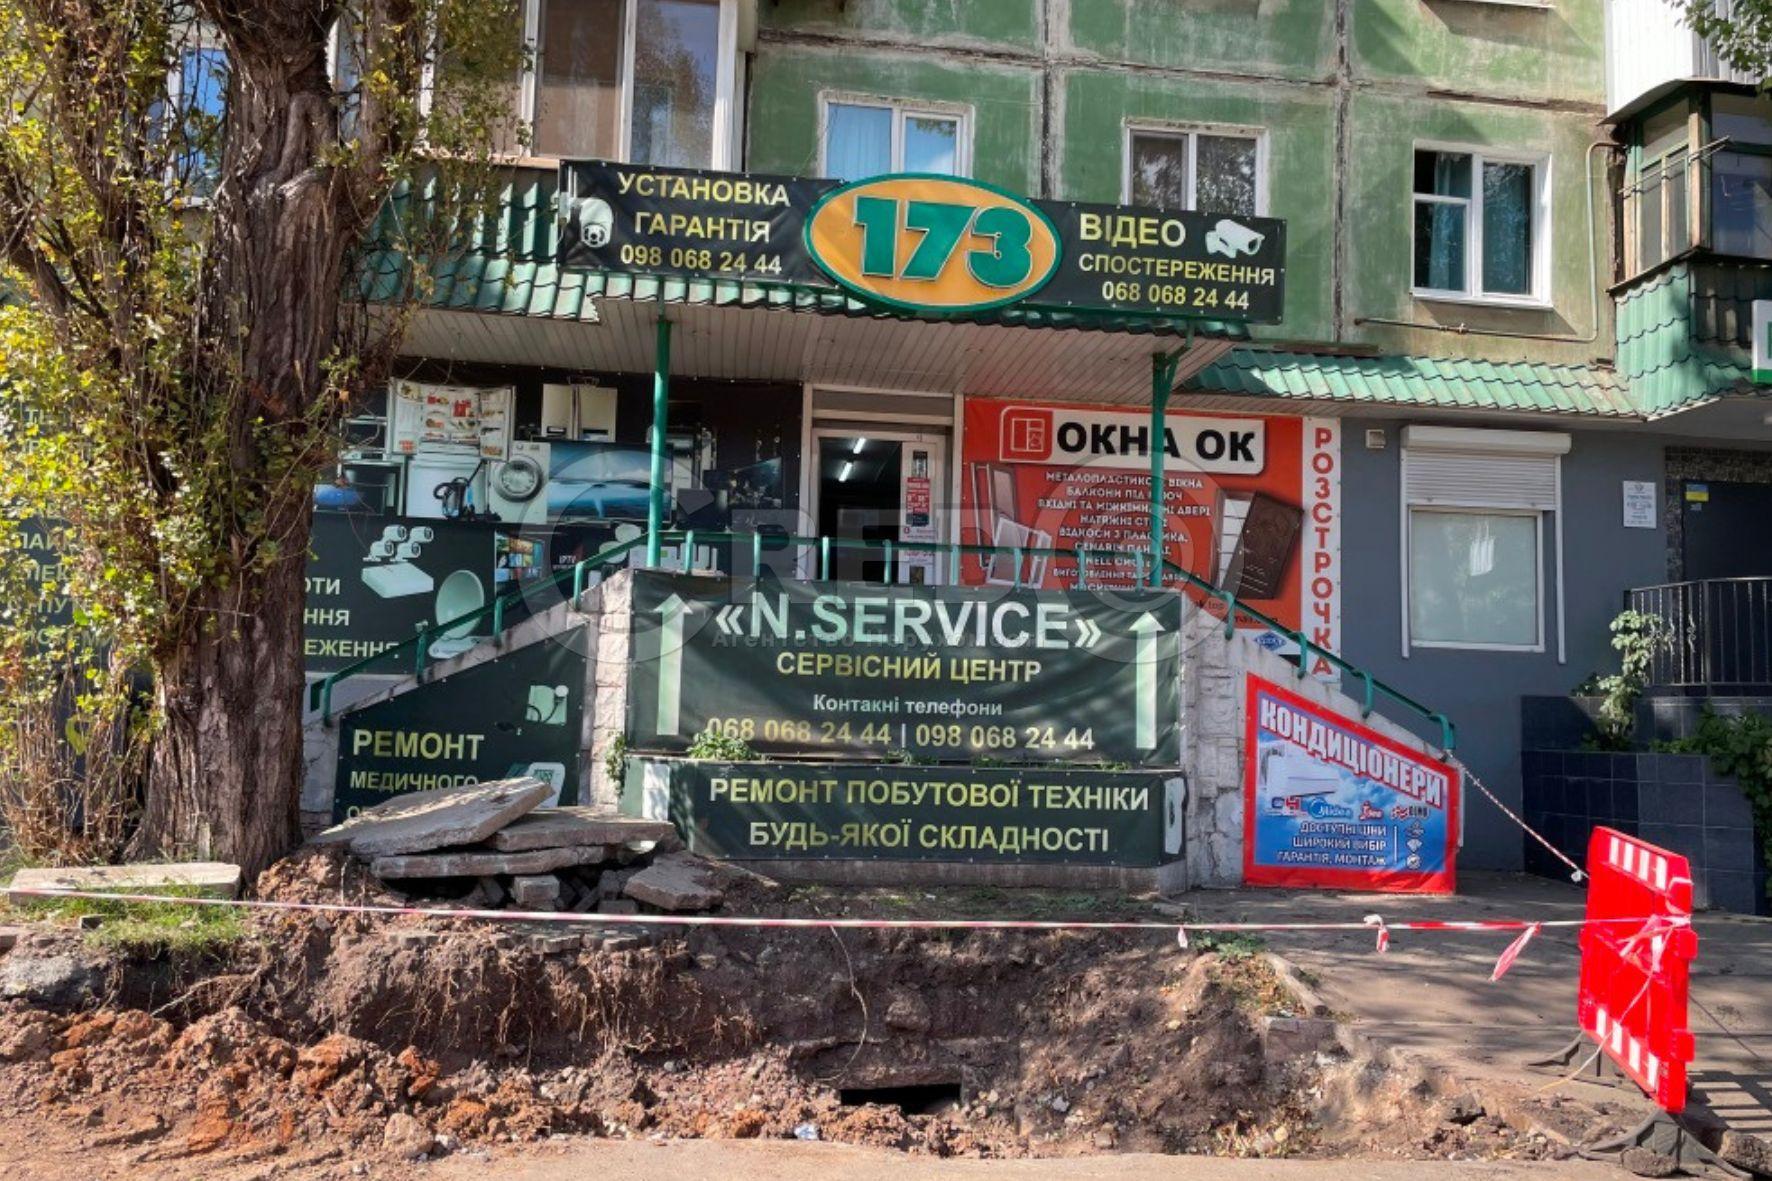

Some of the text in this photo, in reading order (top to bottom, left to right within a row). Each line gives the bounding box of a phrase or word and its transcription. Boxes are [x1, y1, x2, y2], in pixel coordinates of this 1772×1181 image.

[617, 171, 791, 207] УСТАНОВКА
[635, 212, 770, 243] ГАРАНТІЯ
[852, 195, 1033, 289] 173
[1079, 213, 1186, 249] ВІДЕО
[620, 244, 782, 274] 098 068 24 44
[1079, 253, 1275, 286] СПОСТЕРЕЖЕННЯ
[1102, 281, 1249, 310] 068 068 24 44
[1057, 421, 1255, 462] ОКНА ОК
[1046, 472, 1165, 488] МЕТАЛОПЛАСТИКО
[1311, 427, 1334, 675] РОЗСТРОЧКА
[303, 608, 350, 626] ННЯ
[716, 592, 1101, 648] «N.SERVICE»
[777, 652, 1042, 684] СЕРВІСНИЙ ЦЕНТР
[813, 694, 1003, 718] Контакні телефони
[353, 729, 485, 760] РЕМОНТ
[707, 718, 755, 742] 068
[765, 719, 811, 743] 068
[820, 721, 852, 745] 24
[860, 722, 892, 746] 44
[916, 723, 961, 747] 098
[970, 725, 1016, 749] 068
[1025, 727, 1056, 750] 24
[1064, 727, 1095, 750] 44
[1261, 699, 1443, 808] КОНДИЦІОНЕРИ
[351, 770, 478, 793] МЕДИЧНОГО
[710, 778, 1148, 810] РЕМОНТ ПОБУТОВОЇ ТЕХНІКИ
[750, 819, 1108, 854] БУДЬ-ЯКОЇ СКЛАДНОСТІ
